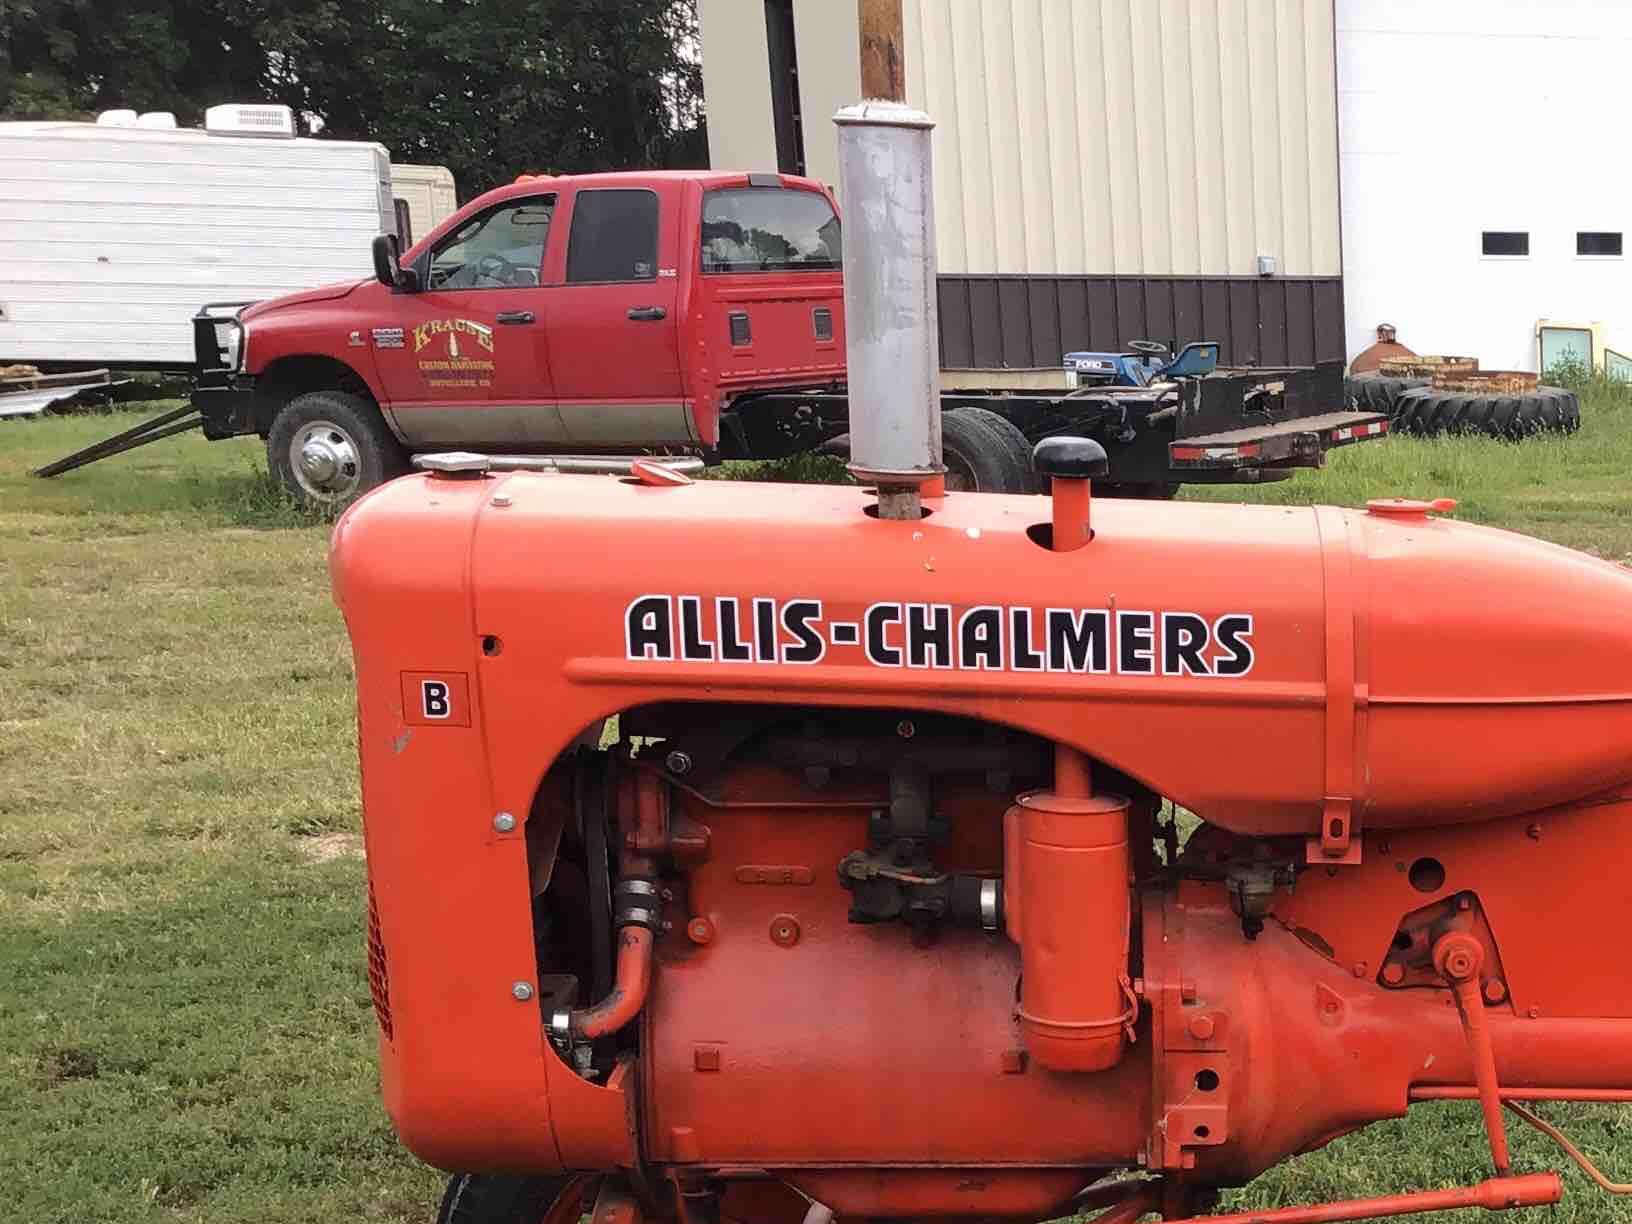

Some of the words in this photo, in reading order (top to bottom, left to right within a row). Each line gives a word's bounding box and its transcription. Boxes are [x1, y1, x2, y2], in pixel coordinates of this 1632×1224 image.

[1075, 359, 1102, 369] FORD
[625, 594, 1253, 678] ALLIS-CHALMERS
[421, 680, 450, 719] B
